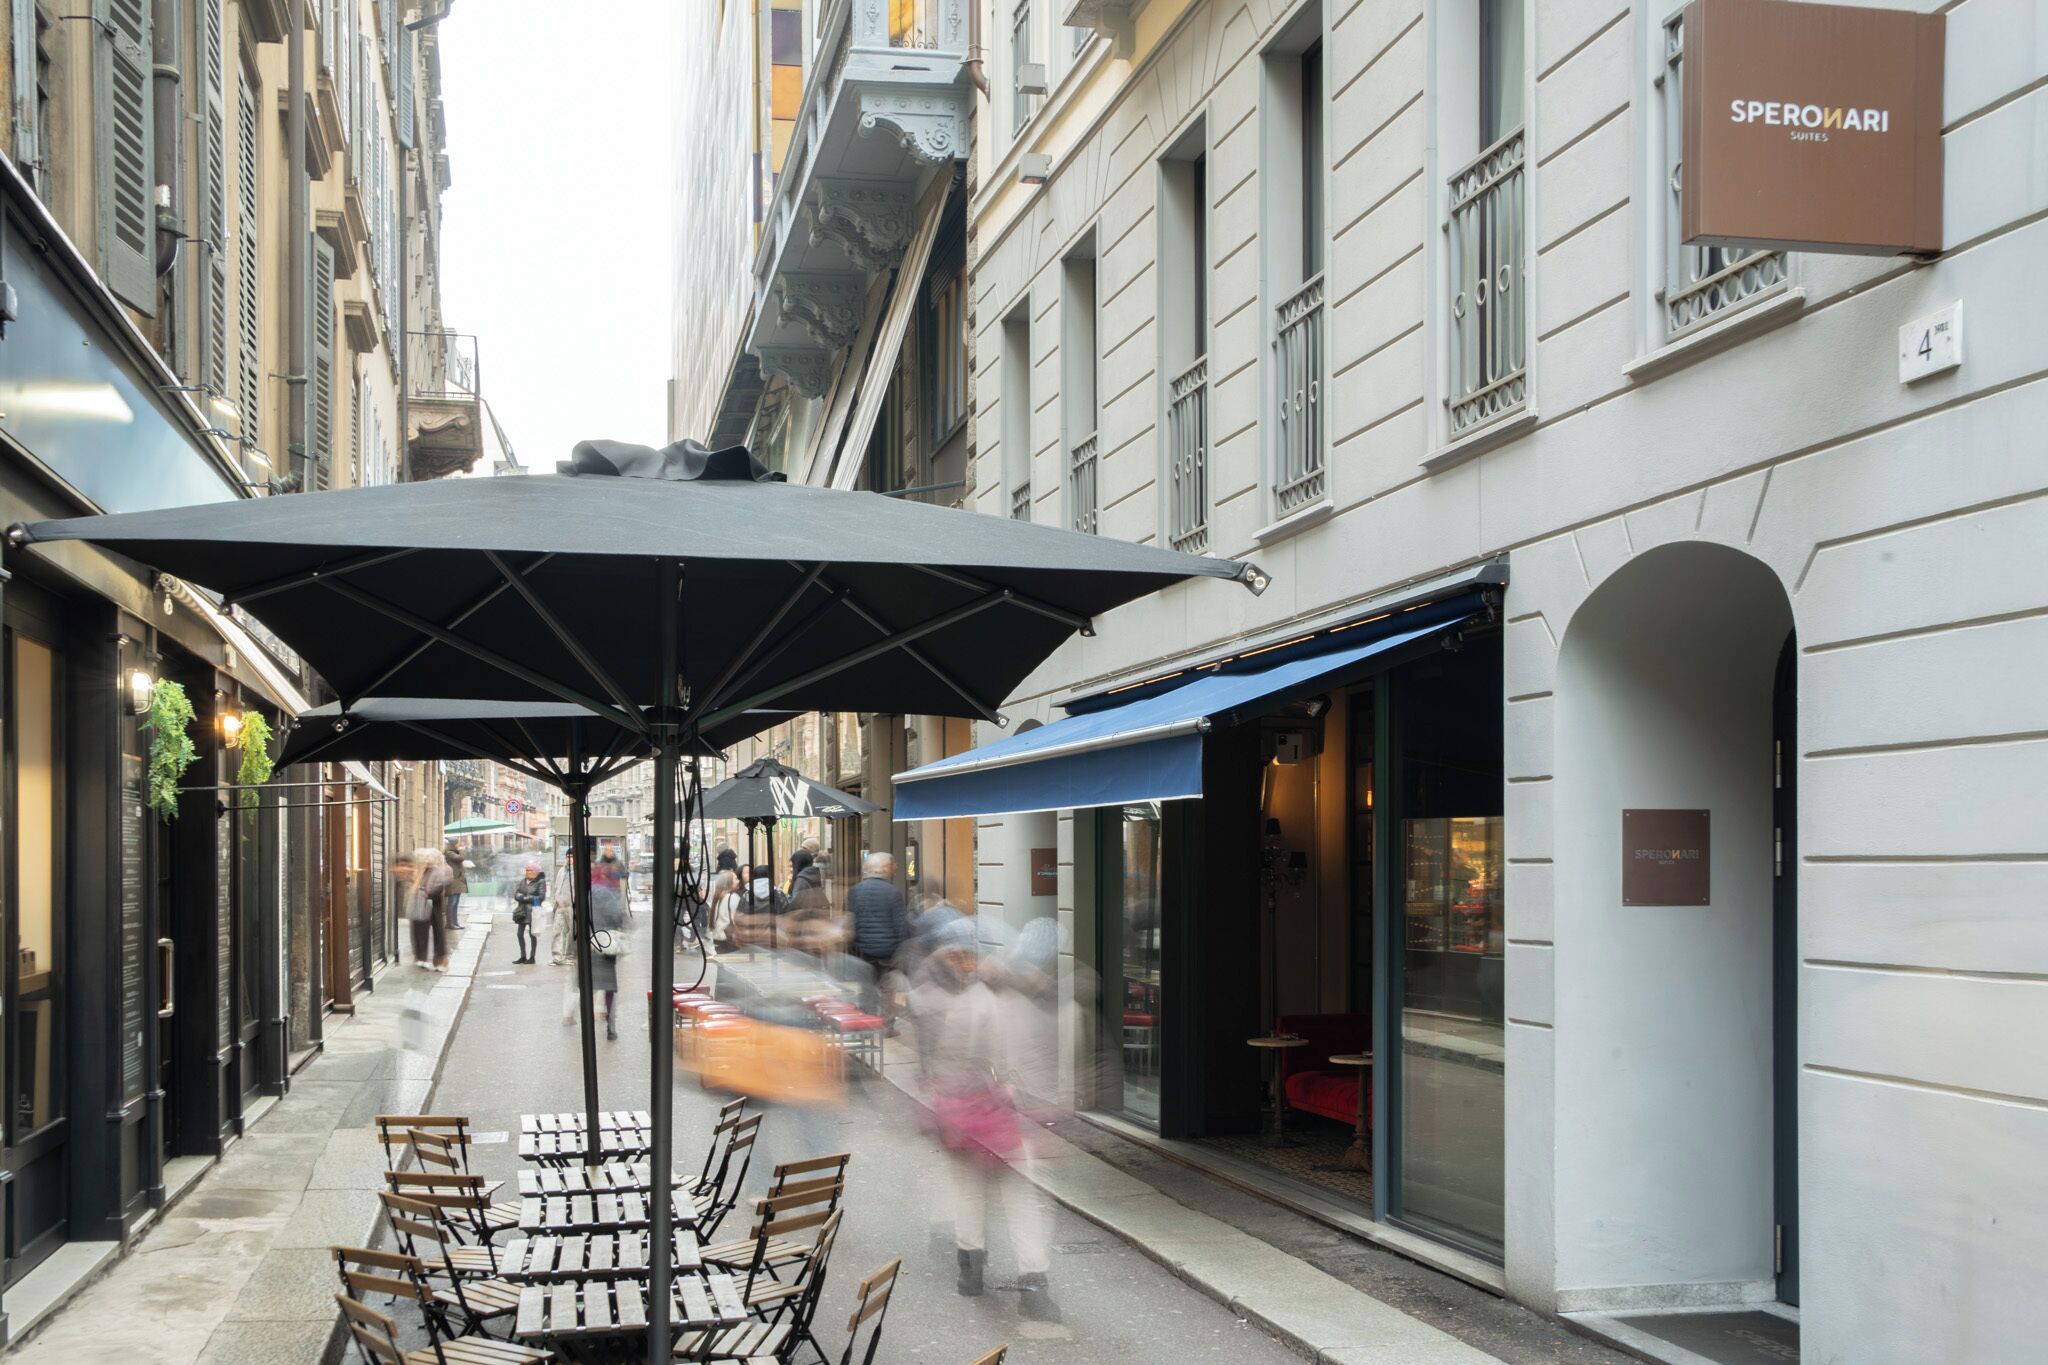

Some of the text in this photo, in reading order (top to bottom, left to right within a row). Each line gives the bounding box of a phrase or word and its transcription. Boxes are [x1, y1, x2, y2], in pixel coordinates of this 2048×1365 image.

[1731, 99, 1889, 133] SPERONARI
[1790, 130, 1829, 143] SUITES
[1918, 328, 1933, 362] 4
